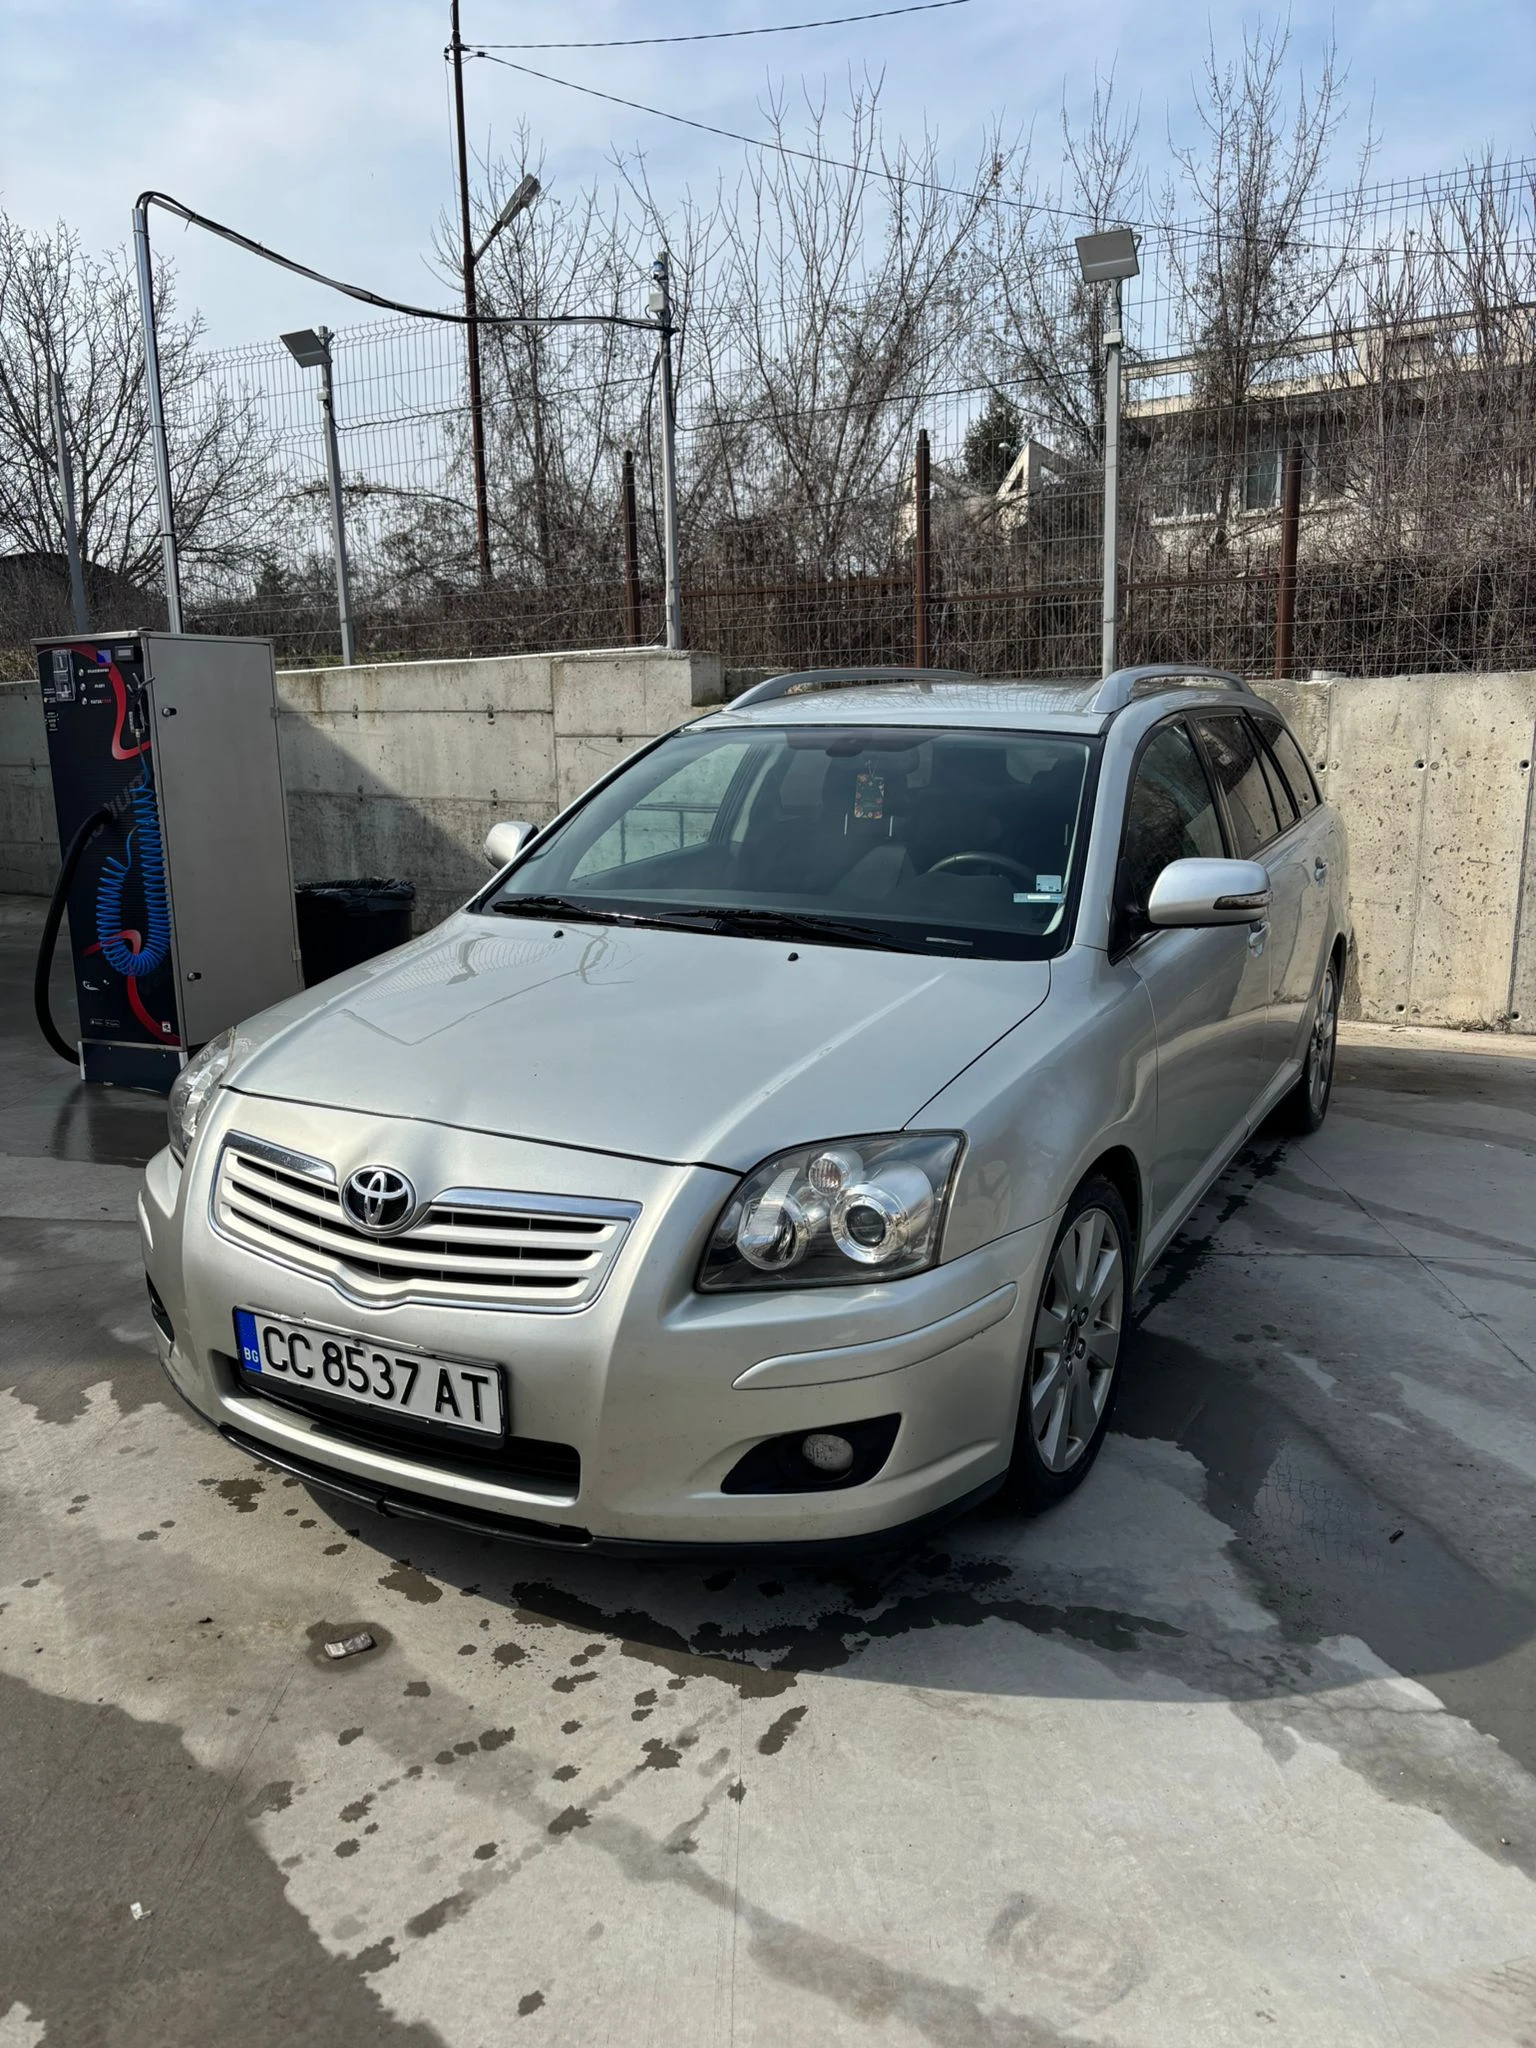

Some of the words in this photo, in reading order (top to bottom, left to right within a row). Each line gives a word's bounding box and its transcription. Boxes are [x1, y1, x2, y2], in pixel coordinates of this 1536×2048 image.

[243, 1346, 260, 1363] BG
[262, 1326, 314, 1379] CC
[321, 1340, 419, 1405] 8537
[434, 1367, 489, 1422] AT
